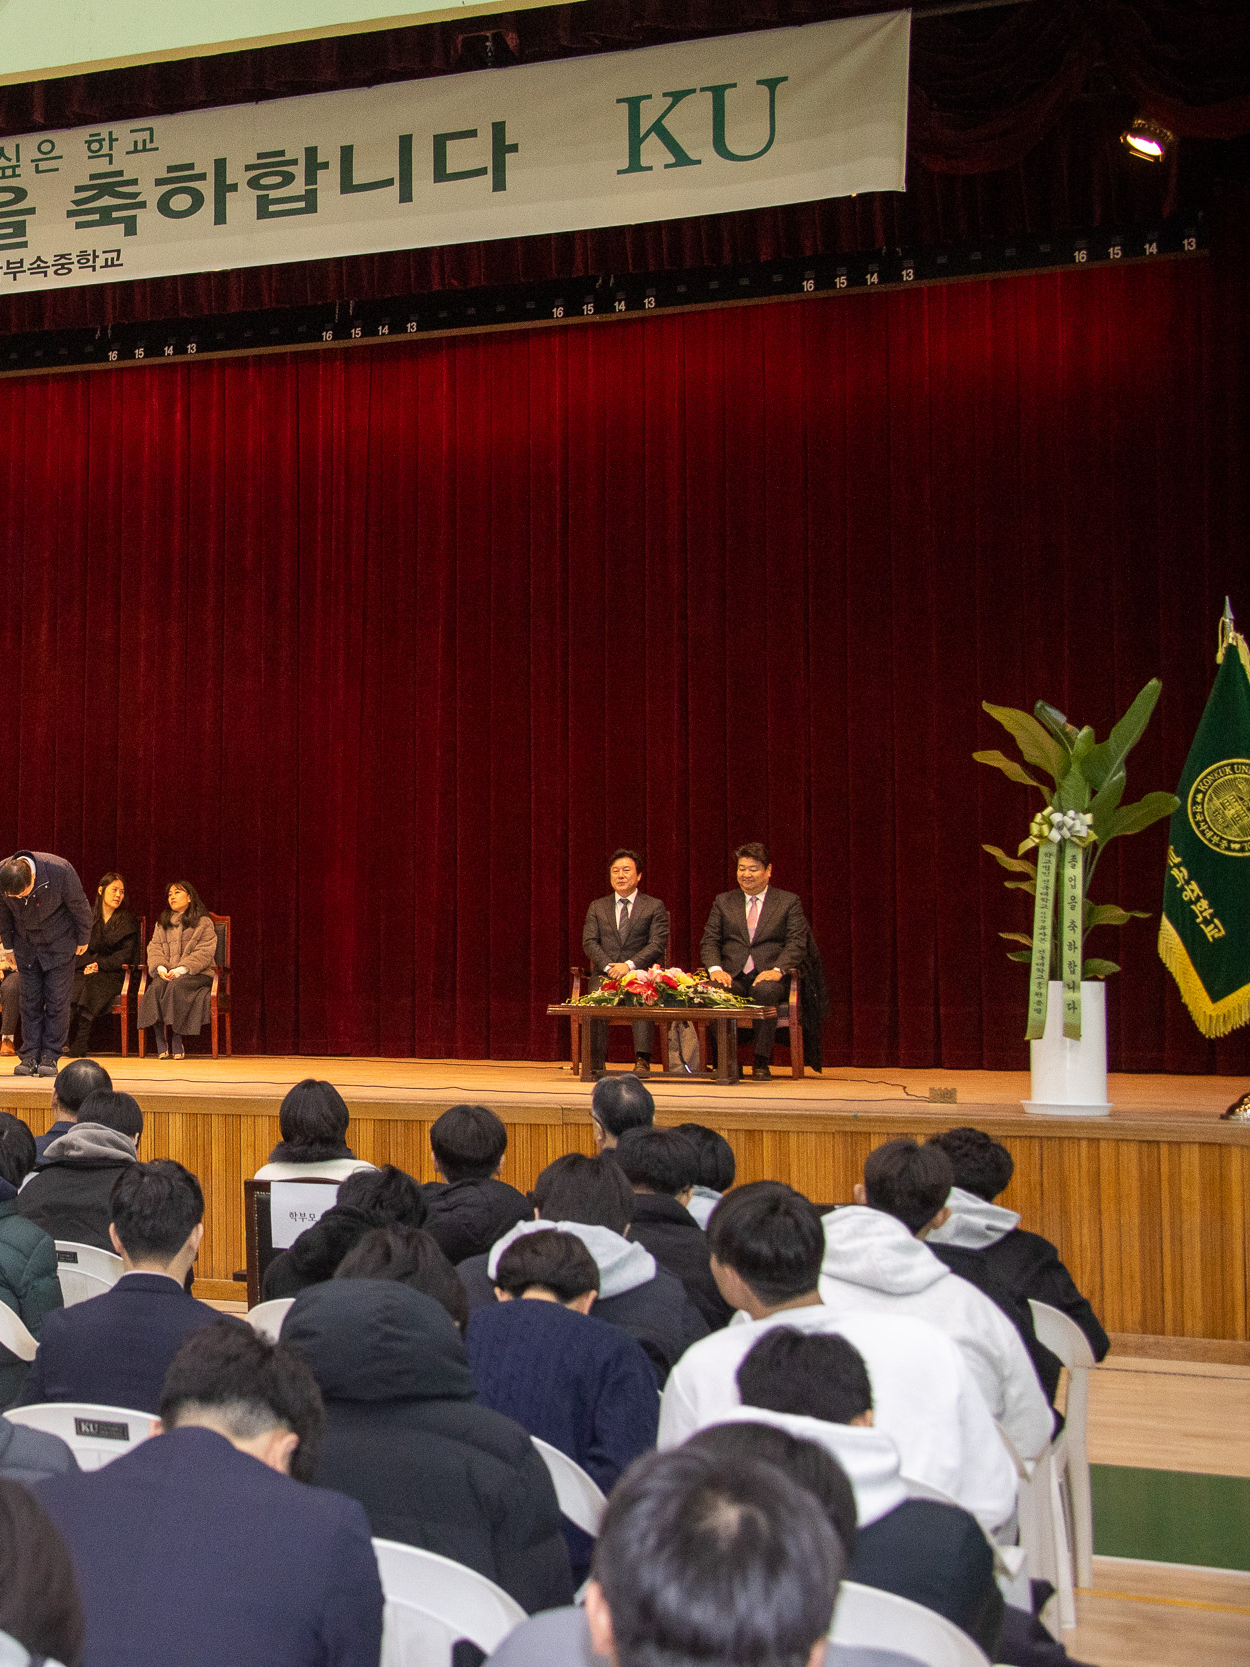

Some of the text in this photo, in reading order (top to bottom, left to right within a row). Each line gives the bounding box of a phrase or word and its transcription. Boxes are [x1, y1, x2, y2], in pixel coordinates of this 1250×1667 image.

[615, 76, 789, 176] KU
[83, 126, 159, 166] 학교
[66, 120, 519, 237] 축하합니다
[1073, 238, 1197, 262] 16 15 14 13
[802, 268, 914, 292] 16 15 14 13
[552, 297, 656, 318] 16 15 14 13
[322, 321, 417, 341] 16 15 14 13
[108, 343, 197, 361] 16 15 14 13
[289, 1211, 318, 1222] 학부모
[81, 1421, 99, 1433] KU
